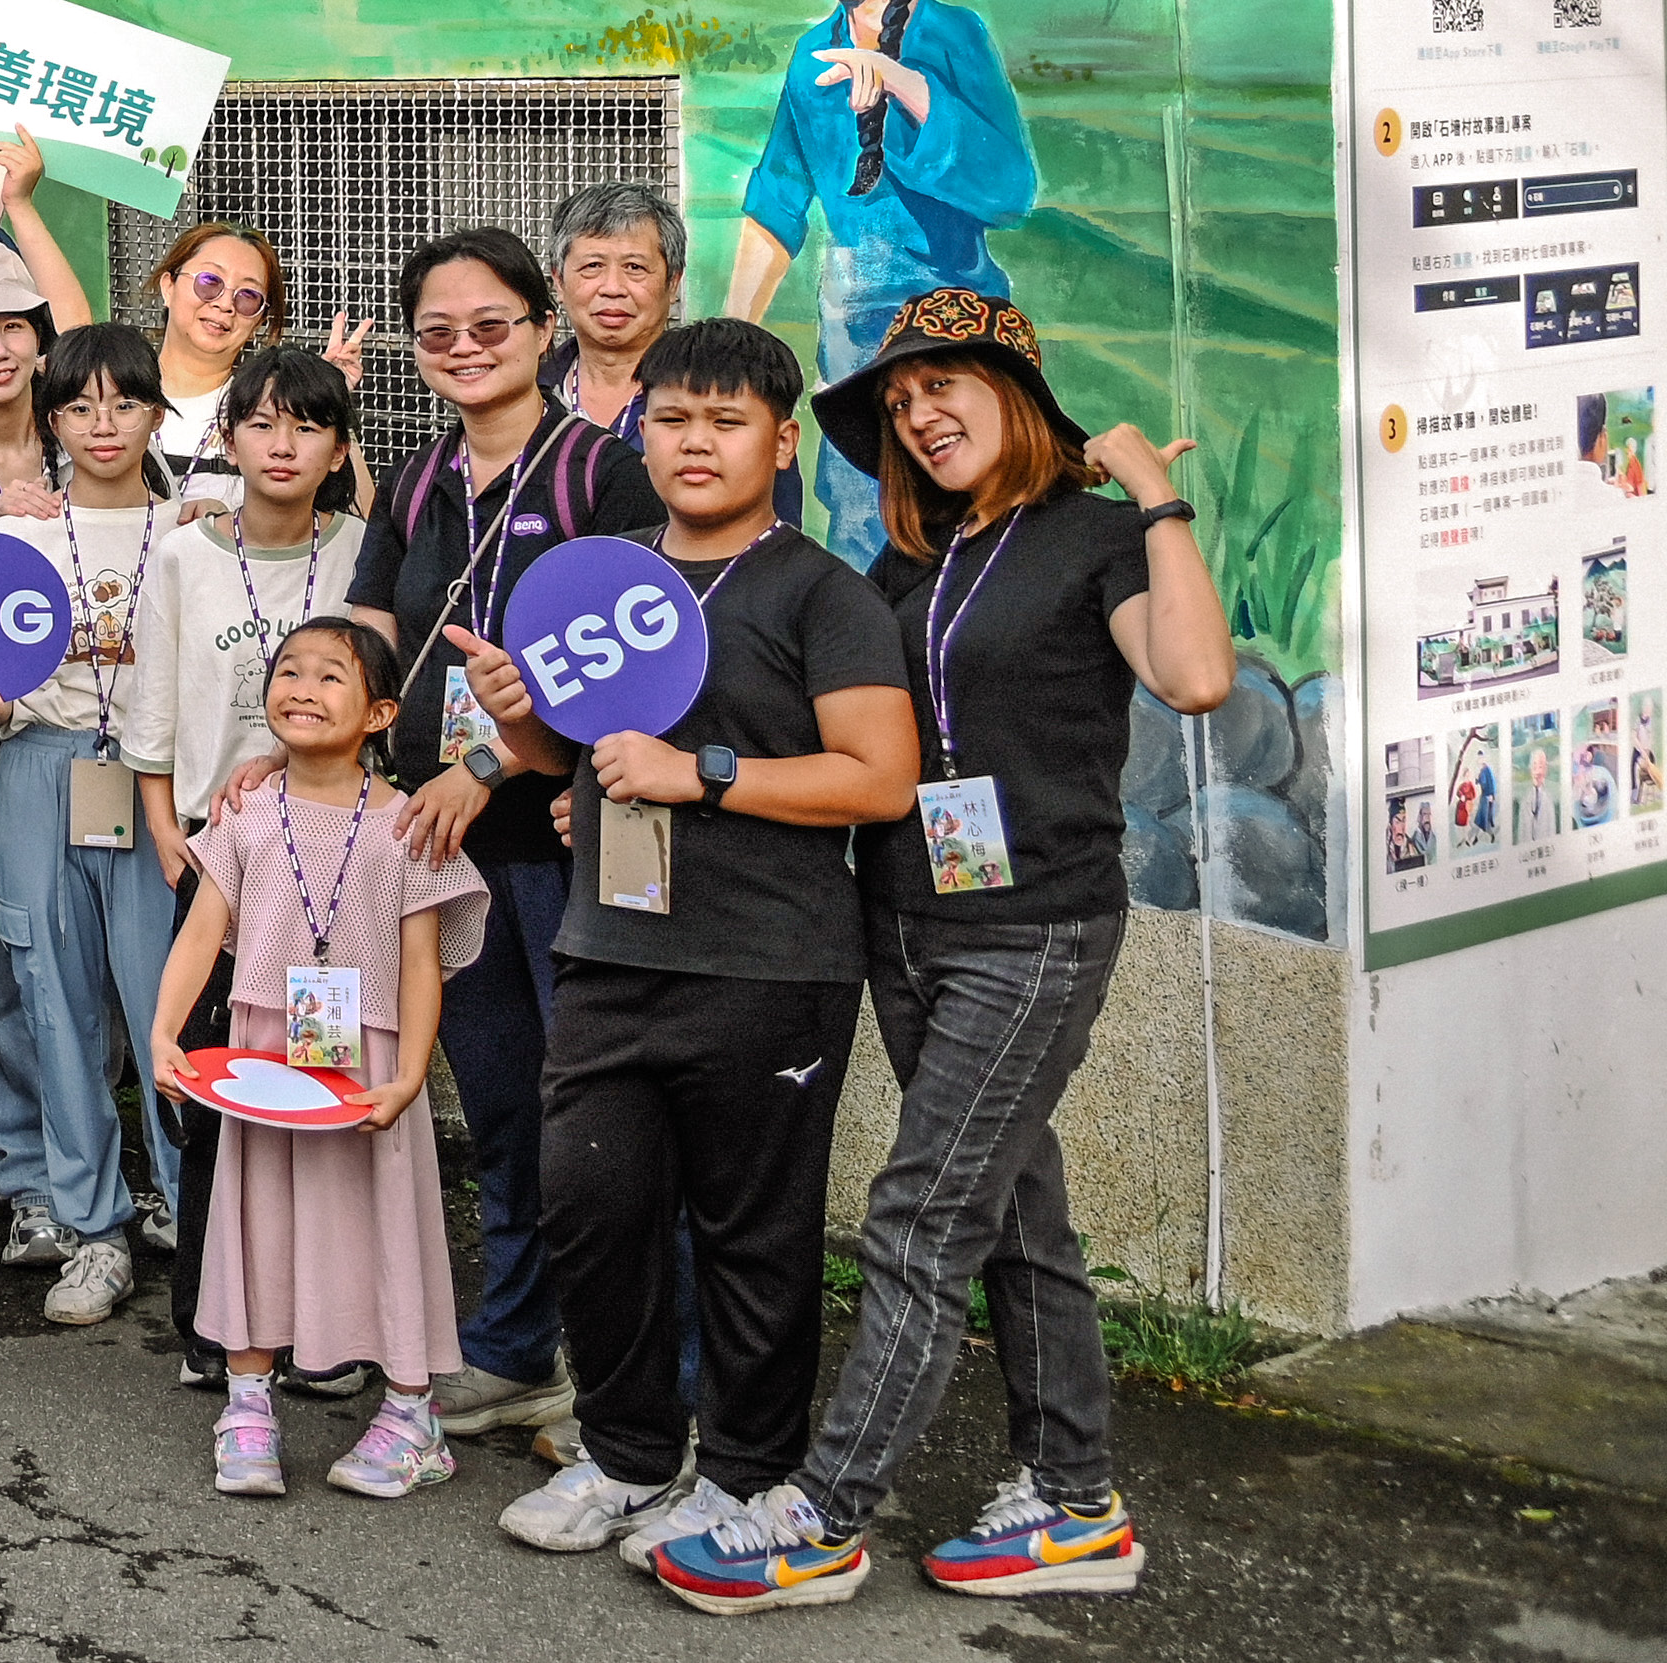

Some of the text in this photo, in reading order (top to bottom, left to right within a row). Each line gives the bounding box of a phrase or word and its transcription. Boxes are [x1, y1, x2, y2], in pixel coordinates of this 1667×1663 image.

[1382, 122, 1391, 143] 2
[1433, 153, 1454, 166] APP
[1388, 418, 1396, 439] 3
[513, 519, 543, 531] BenQ
[521, 584, 679, 707] ESG
[963, 801, 986, 857] 林心梅
[327, 987, 342, 1039] 王湘芸
